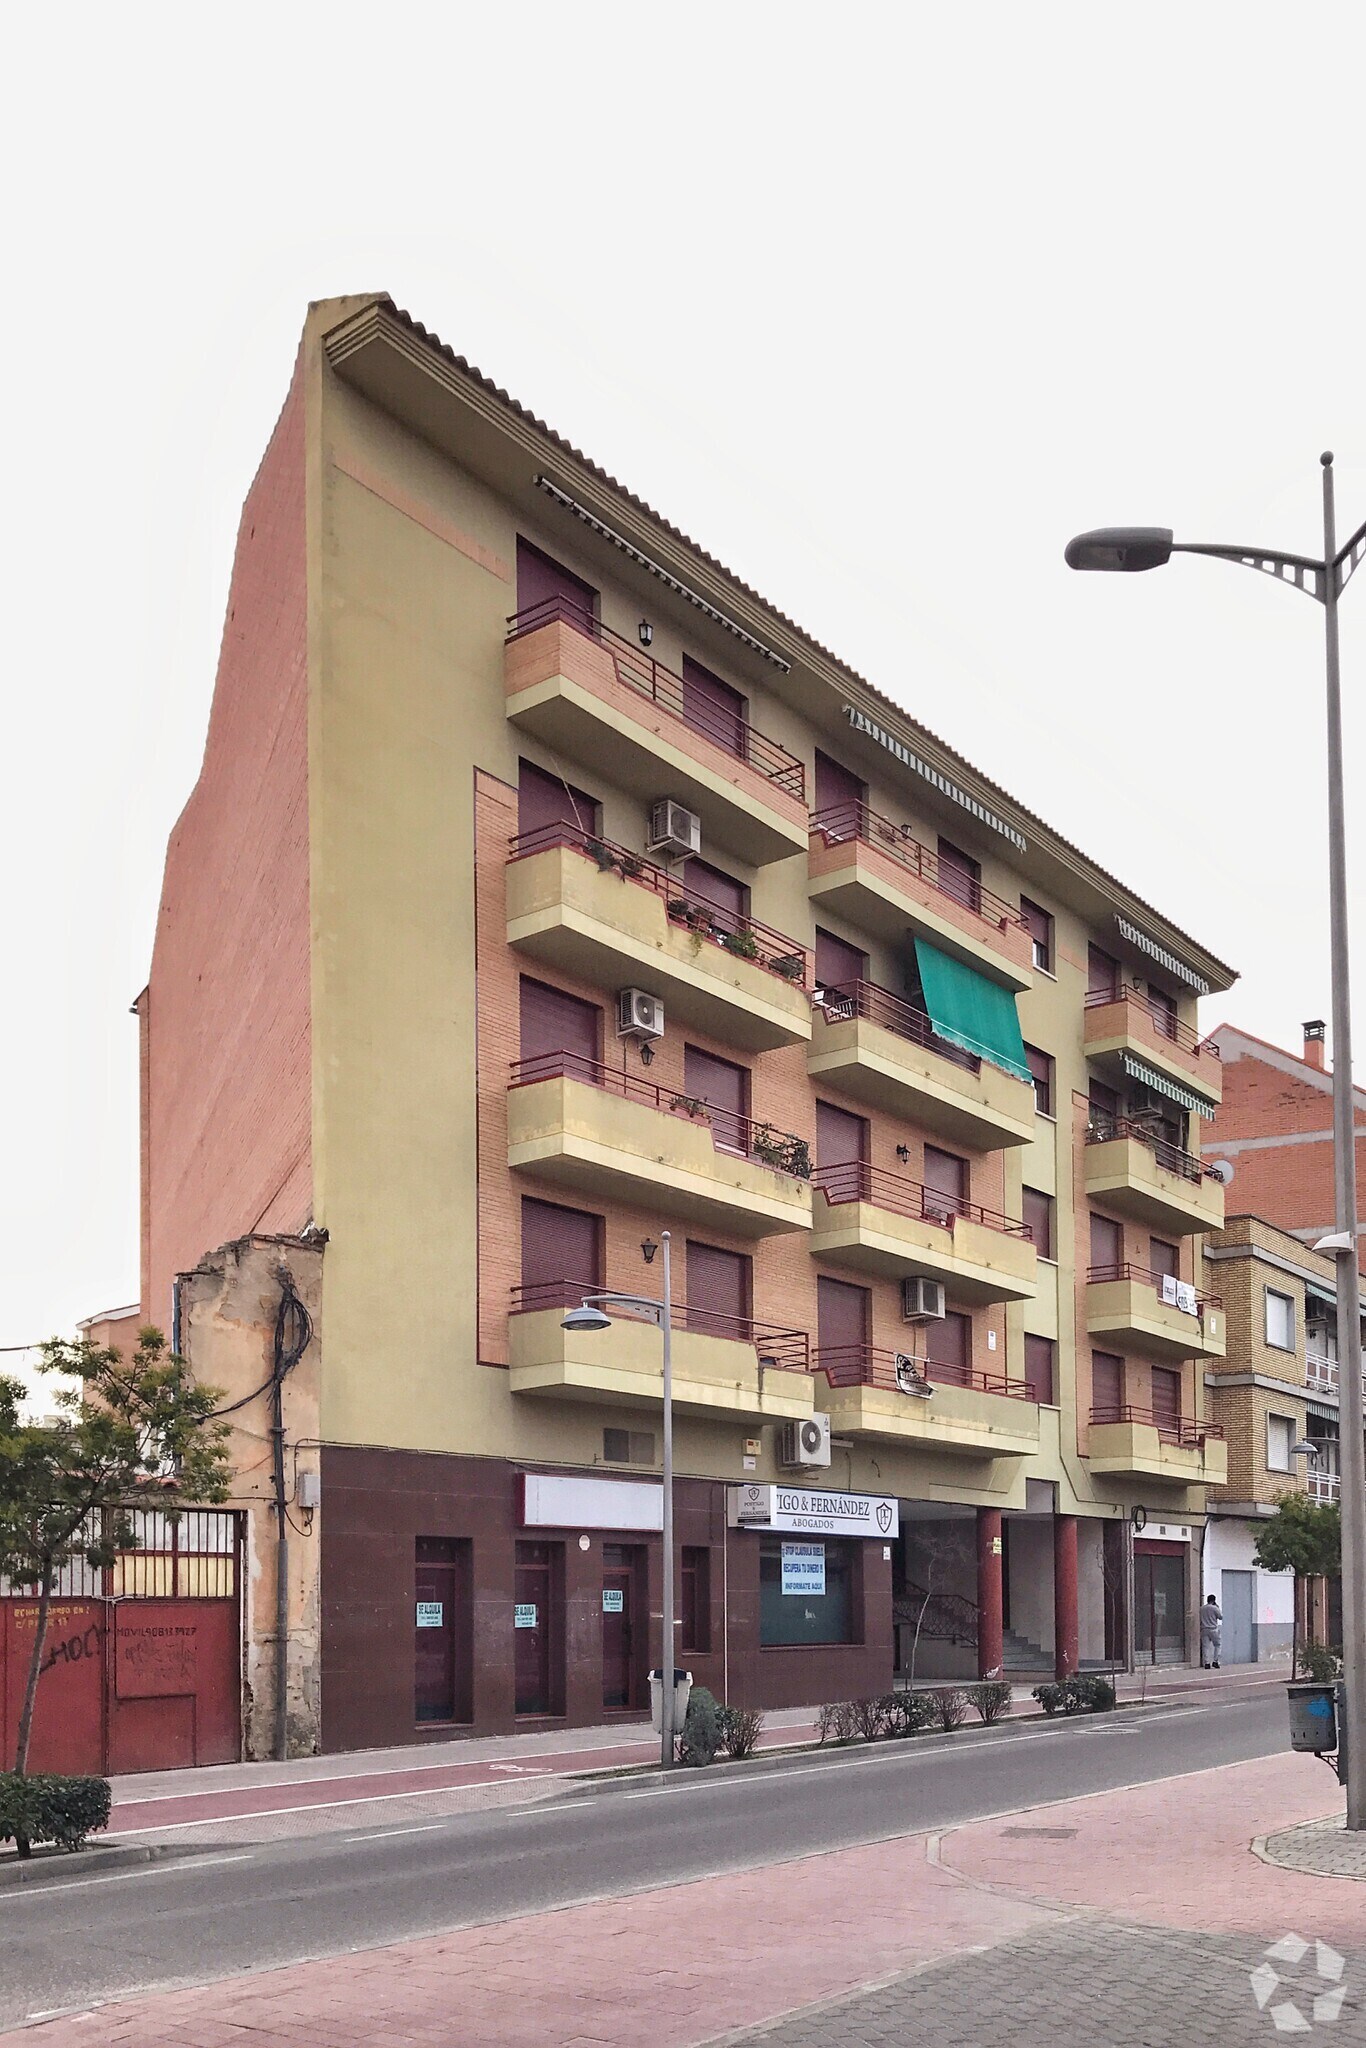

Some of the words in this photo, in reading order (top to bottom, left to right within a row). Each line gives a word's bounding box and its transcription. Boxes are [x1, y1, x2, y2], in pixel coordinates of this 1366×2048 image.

[801, 1496, 808, 1511] &
[811, 1496, 870, 1516] FERNÁNDEZ
[792, 1518, 834, 1529] ABOGADOS
[609, 1592, 621, 1601] ALQUILA
[419, 1604, 424, 1614] SE
[425, 1604, 440, 1614] ALQUILA
[520, 1606, 534, 1616] ALQUILA
